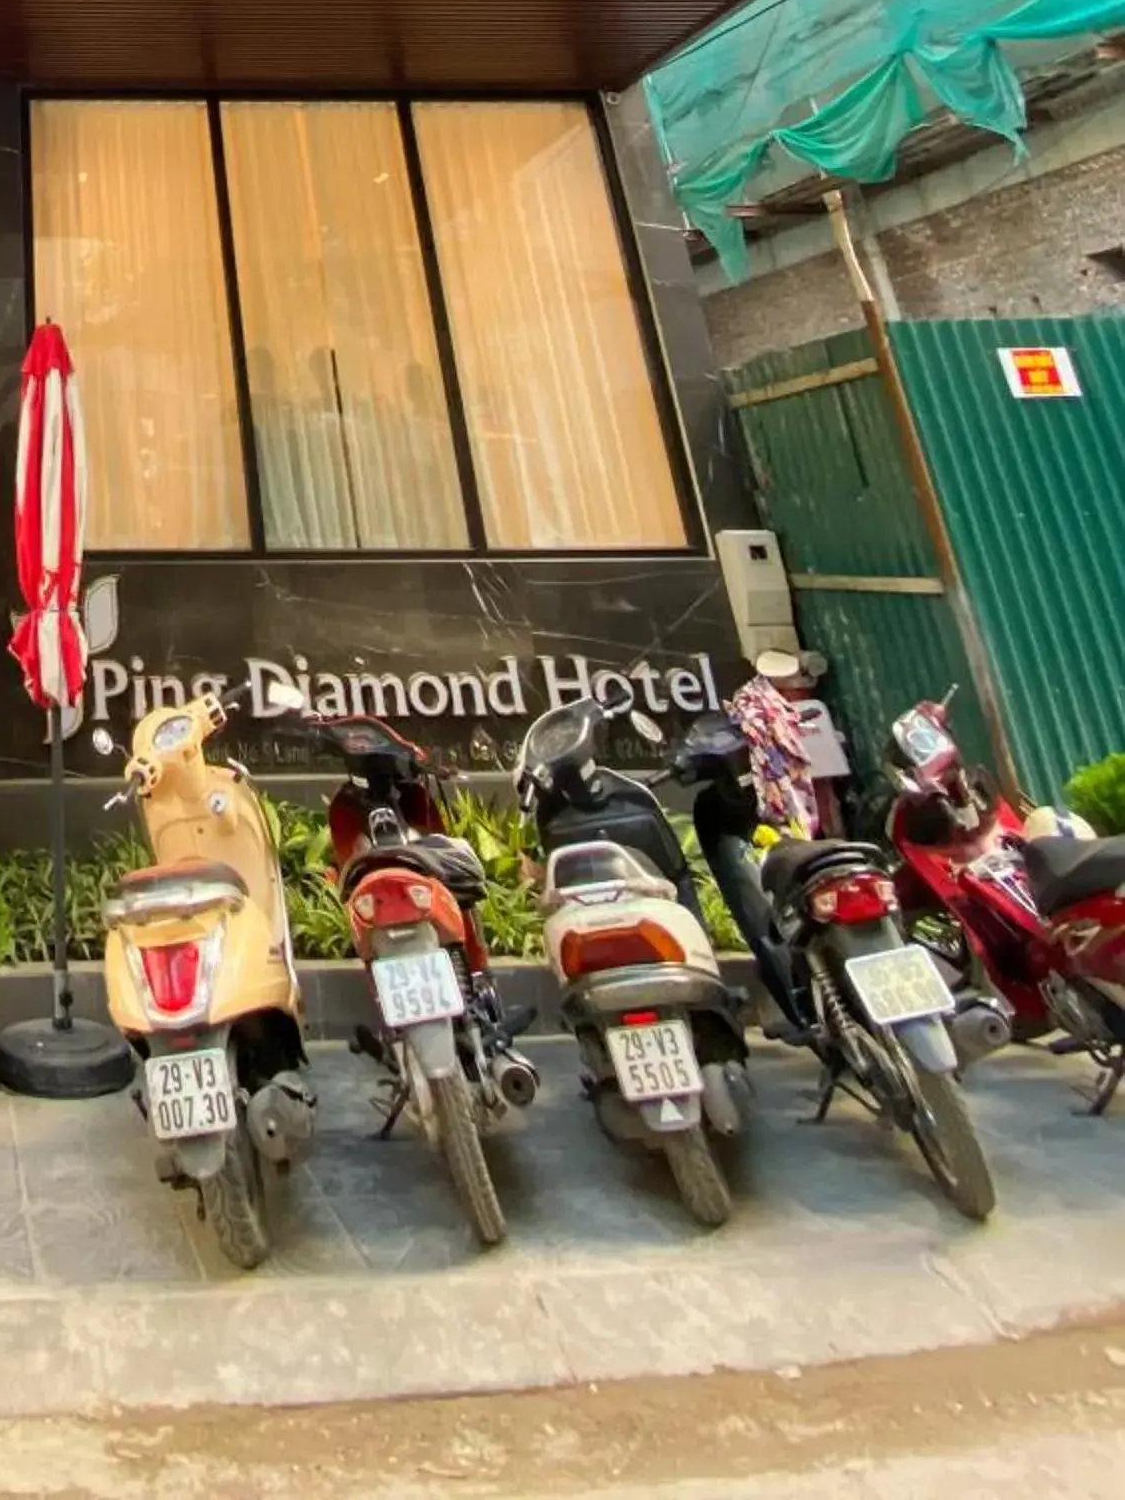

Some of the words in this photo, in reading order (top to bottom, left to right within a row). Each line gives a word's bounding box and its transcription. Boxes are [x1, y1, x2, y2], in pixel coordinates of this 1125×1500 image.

[245, 657, 528, 718] Diamond
[535, 652, 721, 714] Hotel
[628, 1058, 691, 1093] 5505
[158, 1090, 229, 1131] 007.30
